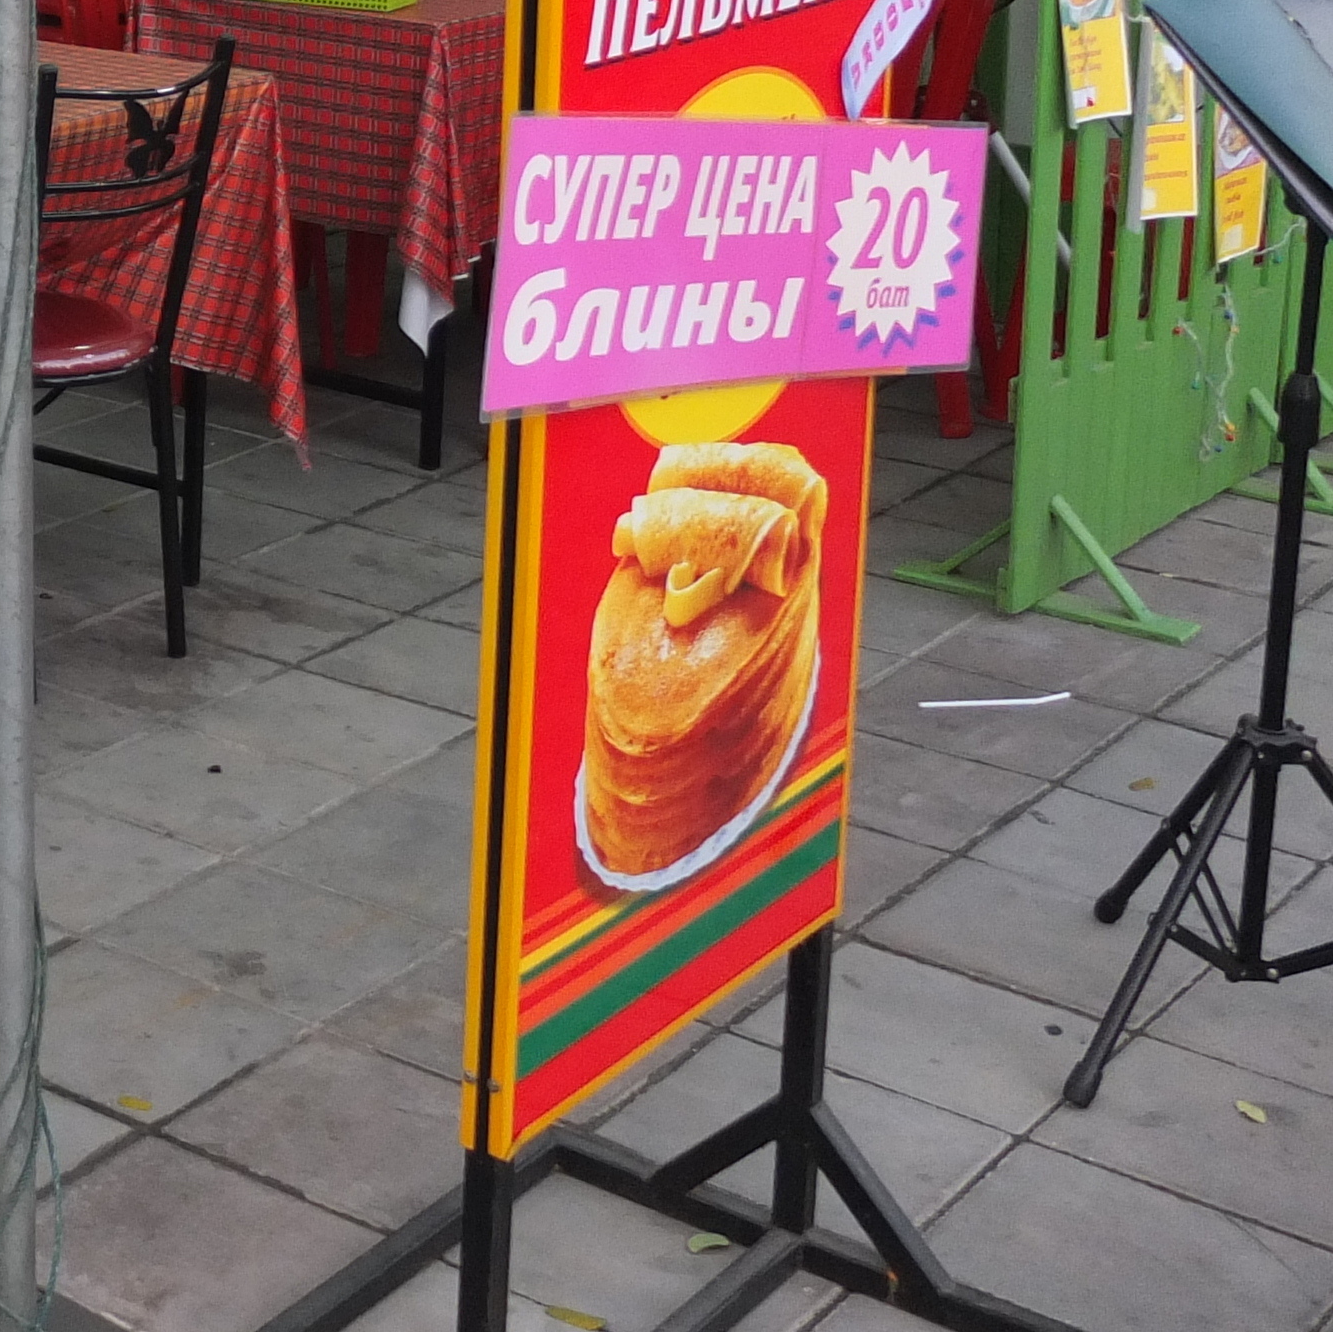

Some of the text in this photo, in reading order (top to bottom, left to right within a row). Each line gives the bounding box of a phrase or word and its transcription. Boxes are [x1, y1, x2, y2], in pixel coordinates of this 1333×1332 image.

[513, 153, 818, 262] СУПЕР ЦЕНА
[850, 186, 928, 270] 20
[502, 267, 805, 366] блины
[865, 278, 910, 309] бат
